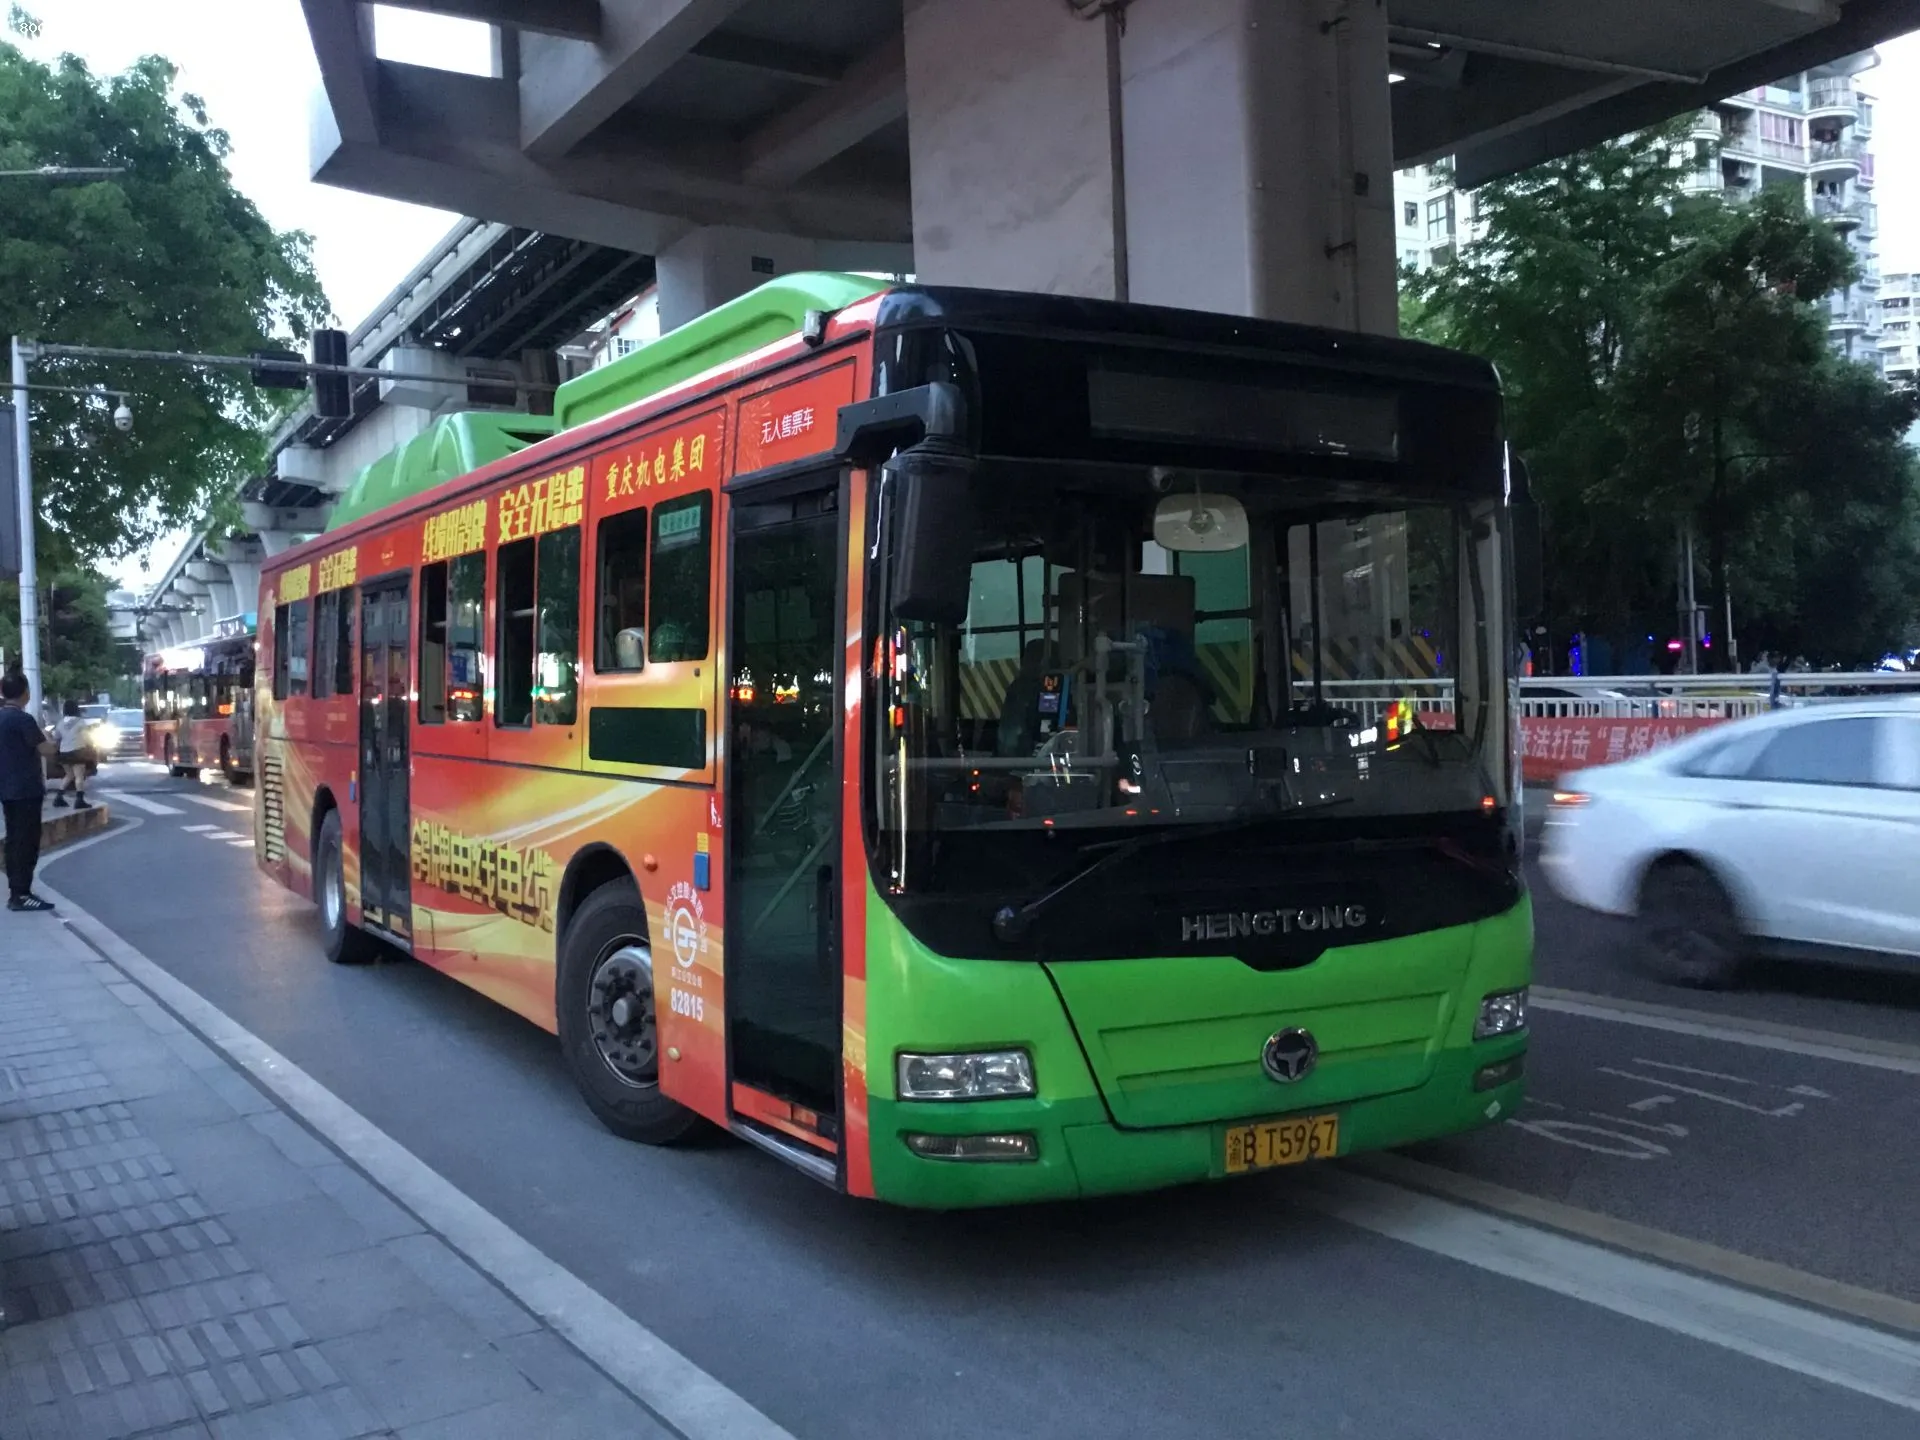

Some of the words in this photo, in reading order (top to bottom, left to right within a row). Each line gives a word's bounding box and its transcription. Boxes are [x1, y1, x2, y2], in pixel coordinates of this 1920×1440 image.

[759, 406, 814, 446] 无人售票车
[604, 433, 707, 502] 重庆机电集团
[498, 465, 585, 545] 安全无隐患
[1181, 903, 1367, 942] HENGTONG
[670, 987, 705, 1022] 82815
